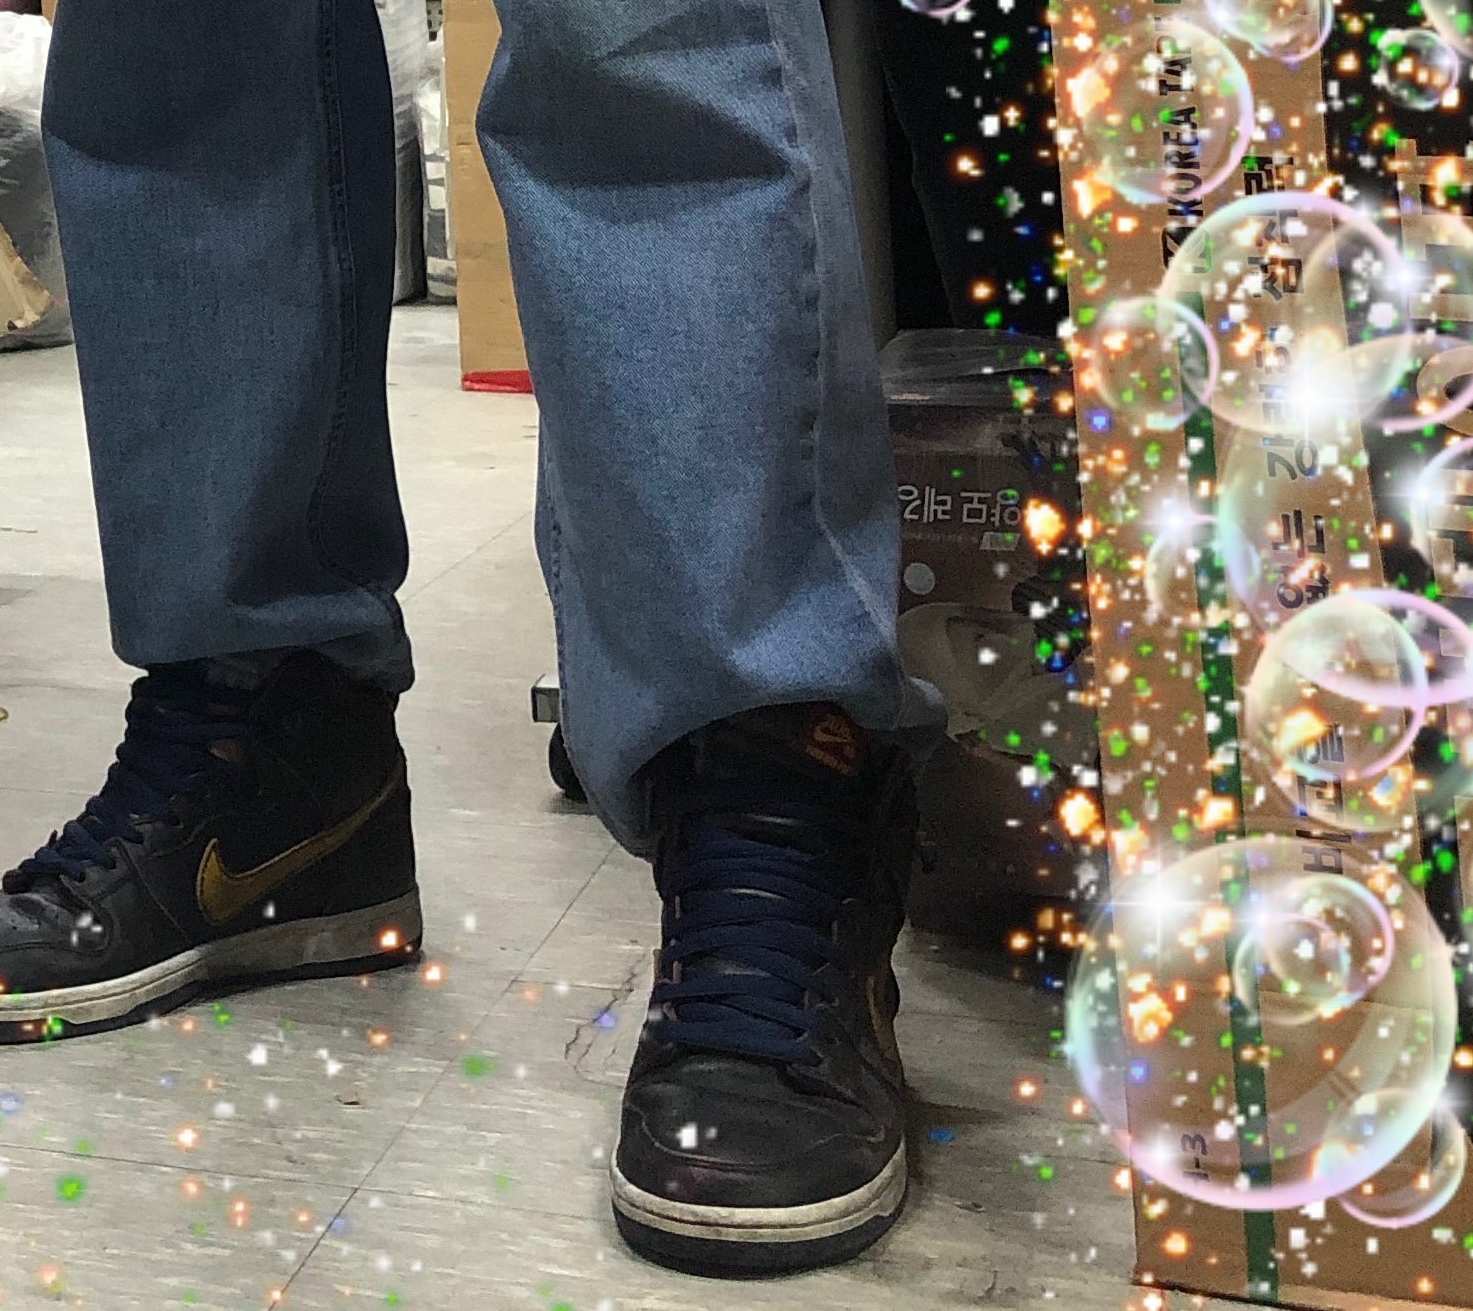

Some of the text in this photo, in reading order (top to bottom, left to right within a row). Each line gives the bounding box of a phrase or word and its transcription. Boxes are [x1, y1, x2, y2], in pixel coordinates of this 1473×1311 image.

[1154, 16, 1194, 96] TAPE
[1161, 107, 1203, 216] KOREA
[960, 489, 1021, 527] 양모
